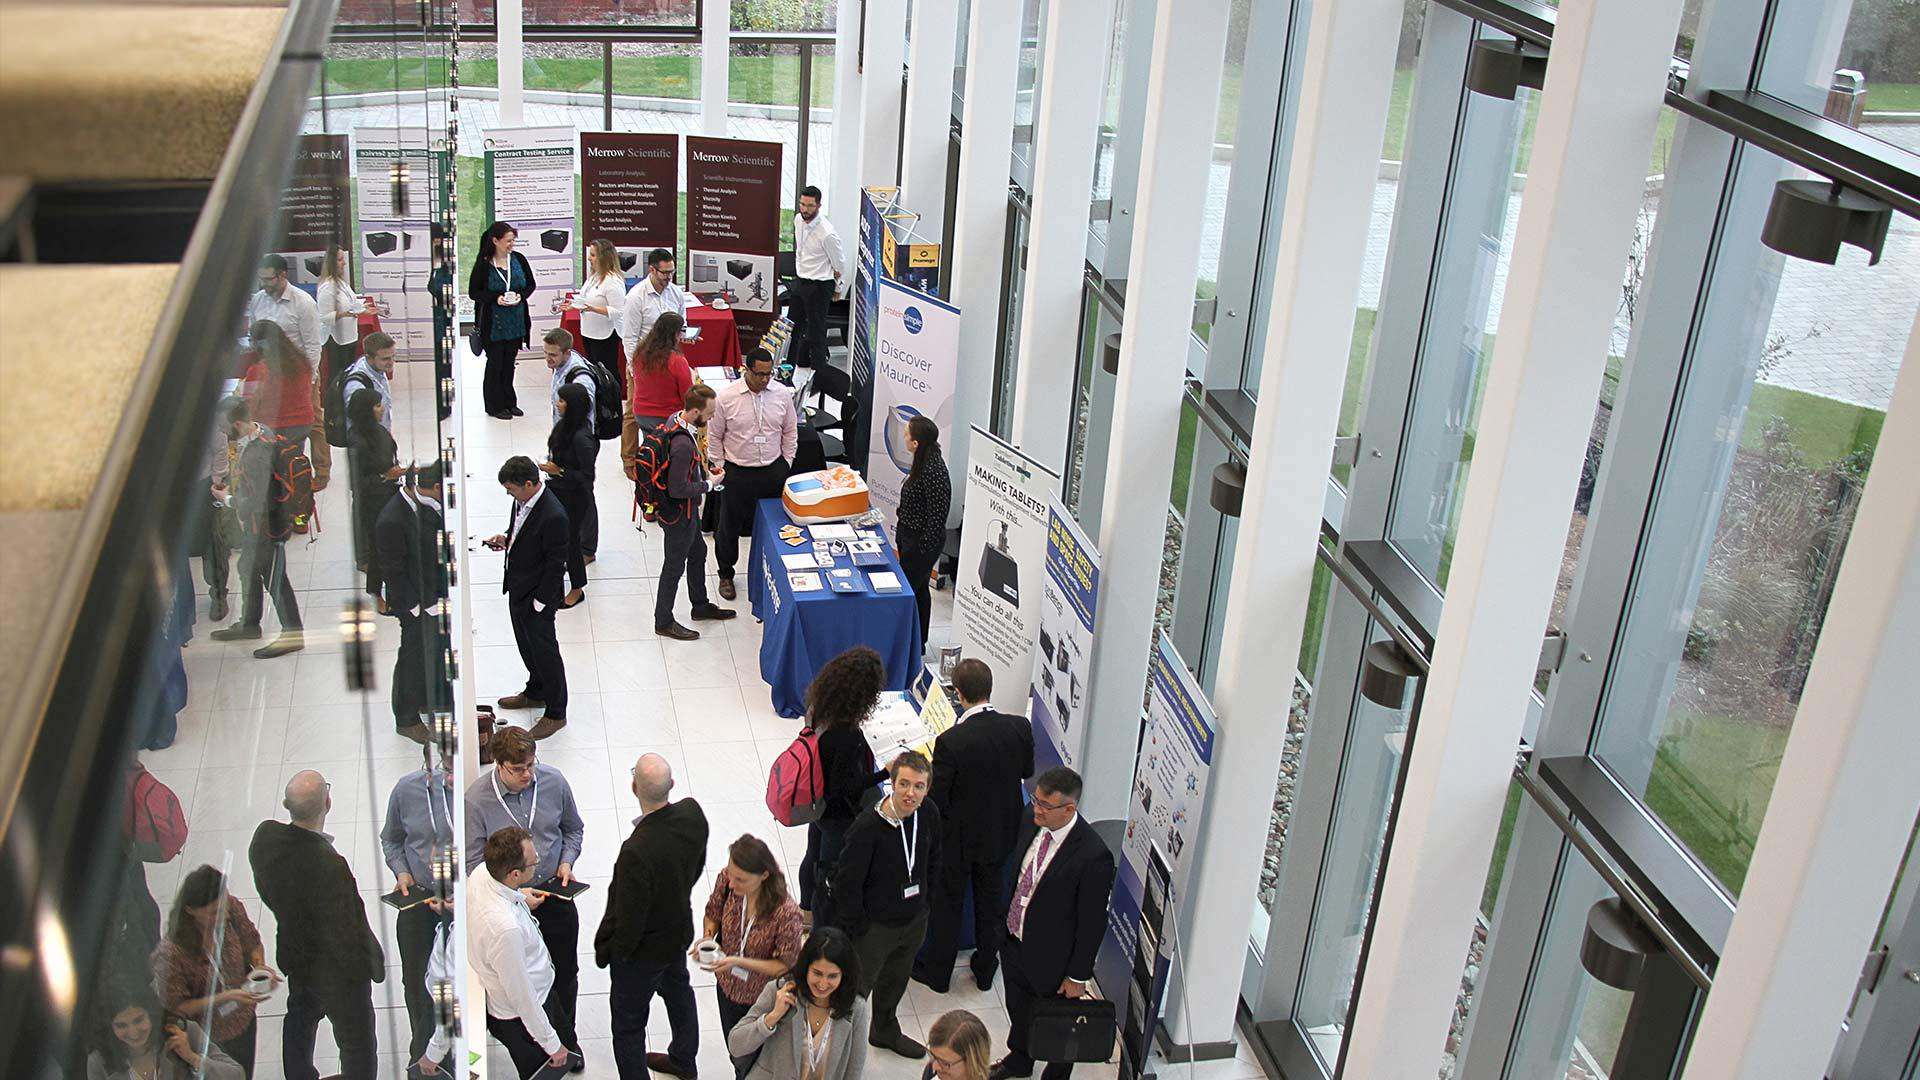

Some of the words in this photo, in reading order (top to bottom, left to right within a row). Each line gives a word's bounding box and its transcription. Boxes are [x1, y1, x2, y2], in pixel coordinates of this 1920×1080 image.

[587, 147, 625, 157] Merrow
[627, 148, 672, 158] Scientific
[692, 151, 730, 162] Merrow
[731, 154, 775, 166] Scientific
[881, 340, 932, 373] Discover
[974, 465, 1007, 492] MAKING
[1009, 485, 1046, 516] TABLETS?
[989, 499, 1005, 516] With
[983, 596, 994, 608] can
[995, 604, 1004, 615] do
[1004, 610, 1013, 621] all
[1013, 616, 1024, 630] this
